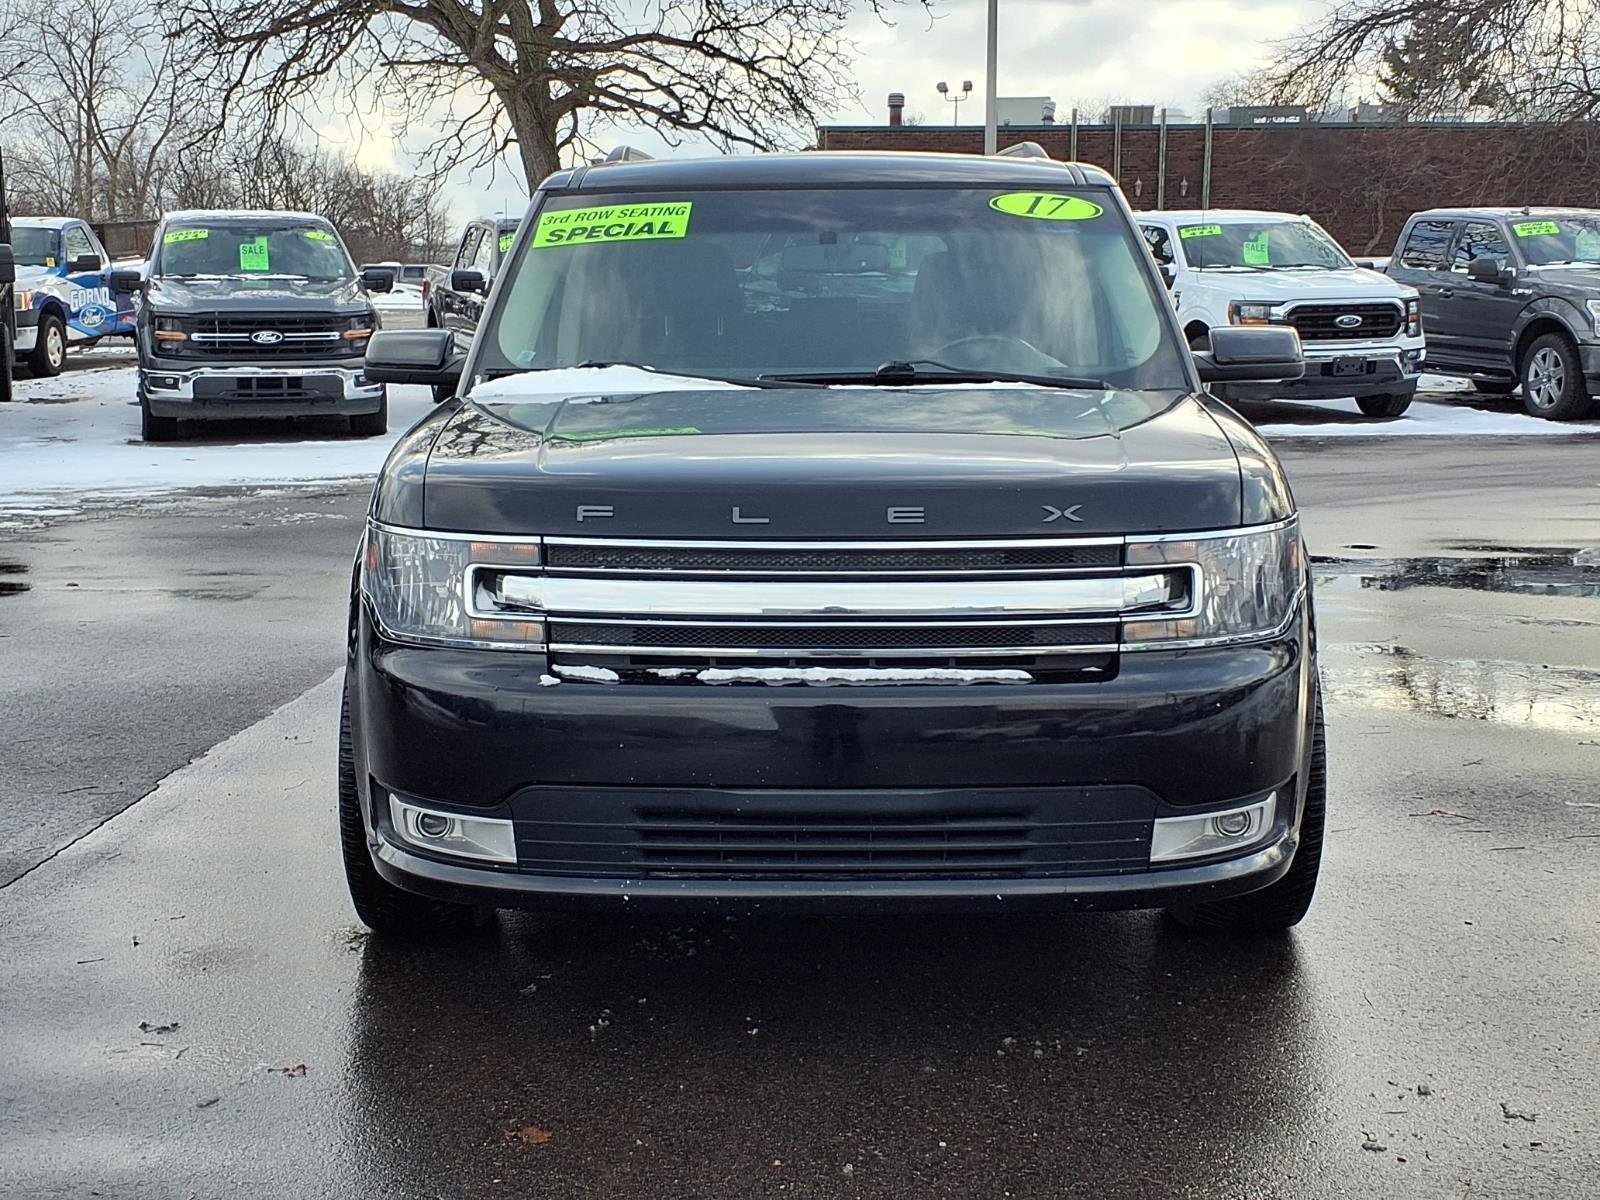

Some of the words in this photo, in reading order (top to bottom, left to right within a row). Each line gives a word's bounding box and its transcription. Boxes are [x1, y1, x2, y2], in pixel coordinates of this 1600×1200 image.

[542, 214, 571, 226] 3rd
[574, 209, 615, 223] ROW
[617, 205, 688, 219] SEATING
[1022, 195, 1071, 216] 17
[545, 221, 676, 244] SPECIAL
[241, 245, 265, 255] SALE
[1245, 243, 1266, 253] SALE
[70, 287, 109, 312] GORNO
[83, 308, 102, 324] Ford
